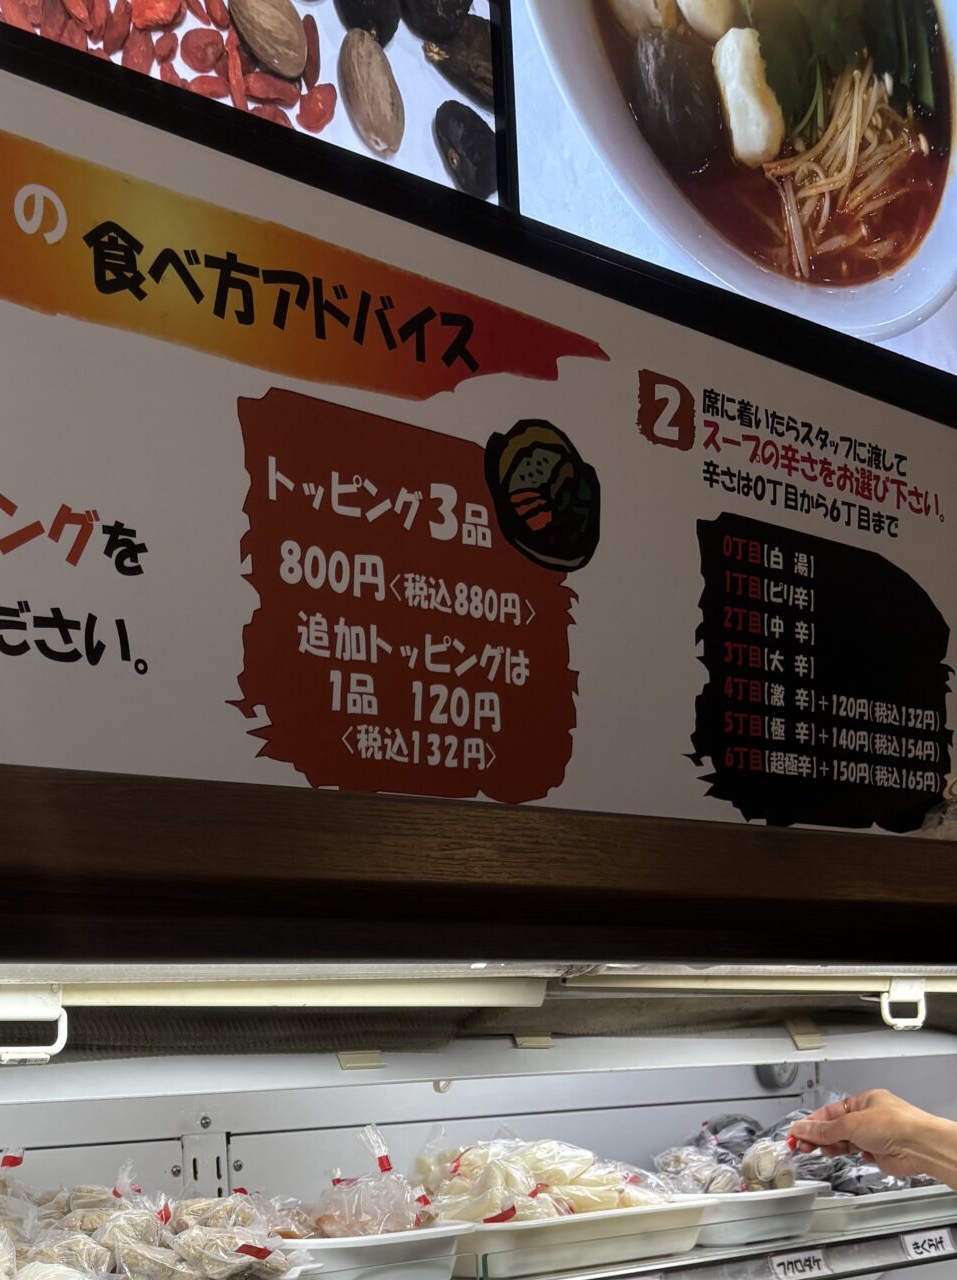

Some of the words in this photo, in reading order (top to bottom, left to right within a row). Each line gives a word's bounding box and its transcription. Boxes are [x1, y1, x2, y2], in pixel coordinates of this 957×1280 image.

[653, 383, 681, 441] 2
[702, 388, 908, 477] 席に着いたらスタッフに渡して
[267, 456, 492, 548] トッピング3品
[702, 420, 945, 523] スープの辛さをお選び下さい。
[702, 460, 899, 538] 辛さは0丁目から6丁目まで
[297, 611, 530, 686] 追加トッピングは
[776, 1256, 822, 1277] フクロダケ
[912, 1236, 944, 1256] きくらげ
